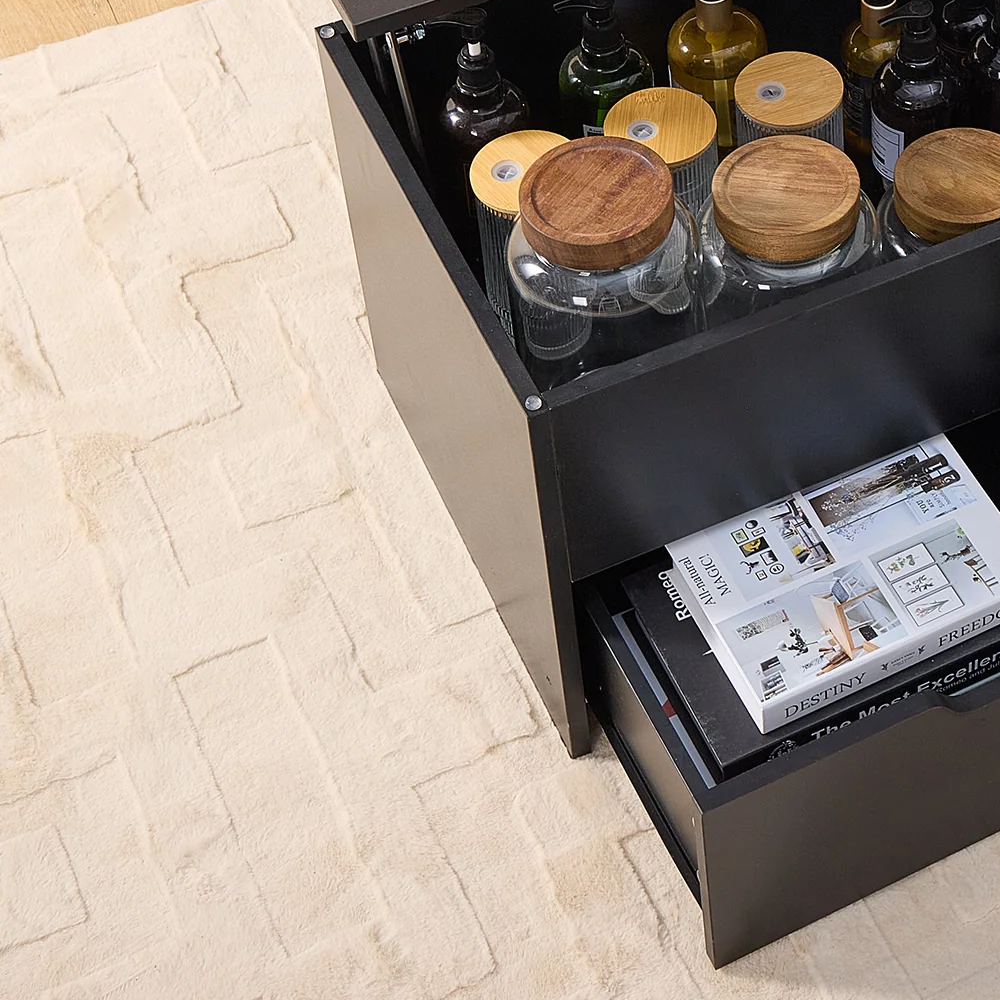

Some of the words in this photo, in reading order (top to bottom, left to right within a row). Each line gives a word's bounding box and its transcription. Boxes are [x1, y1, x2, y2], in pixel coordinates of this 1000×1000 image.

[658, 571, 692, 622] Romeo
[678, 556, 716, 606] All-natural
[698, 553, 732, 596] MAGIC!
[784, 672, 866, 719] DESTINY
[935, 676, 967, 693] Romeo
[968, 667, 987, 681] and
[811, 721, 852, 741] The
